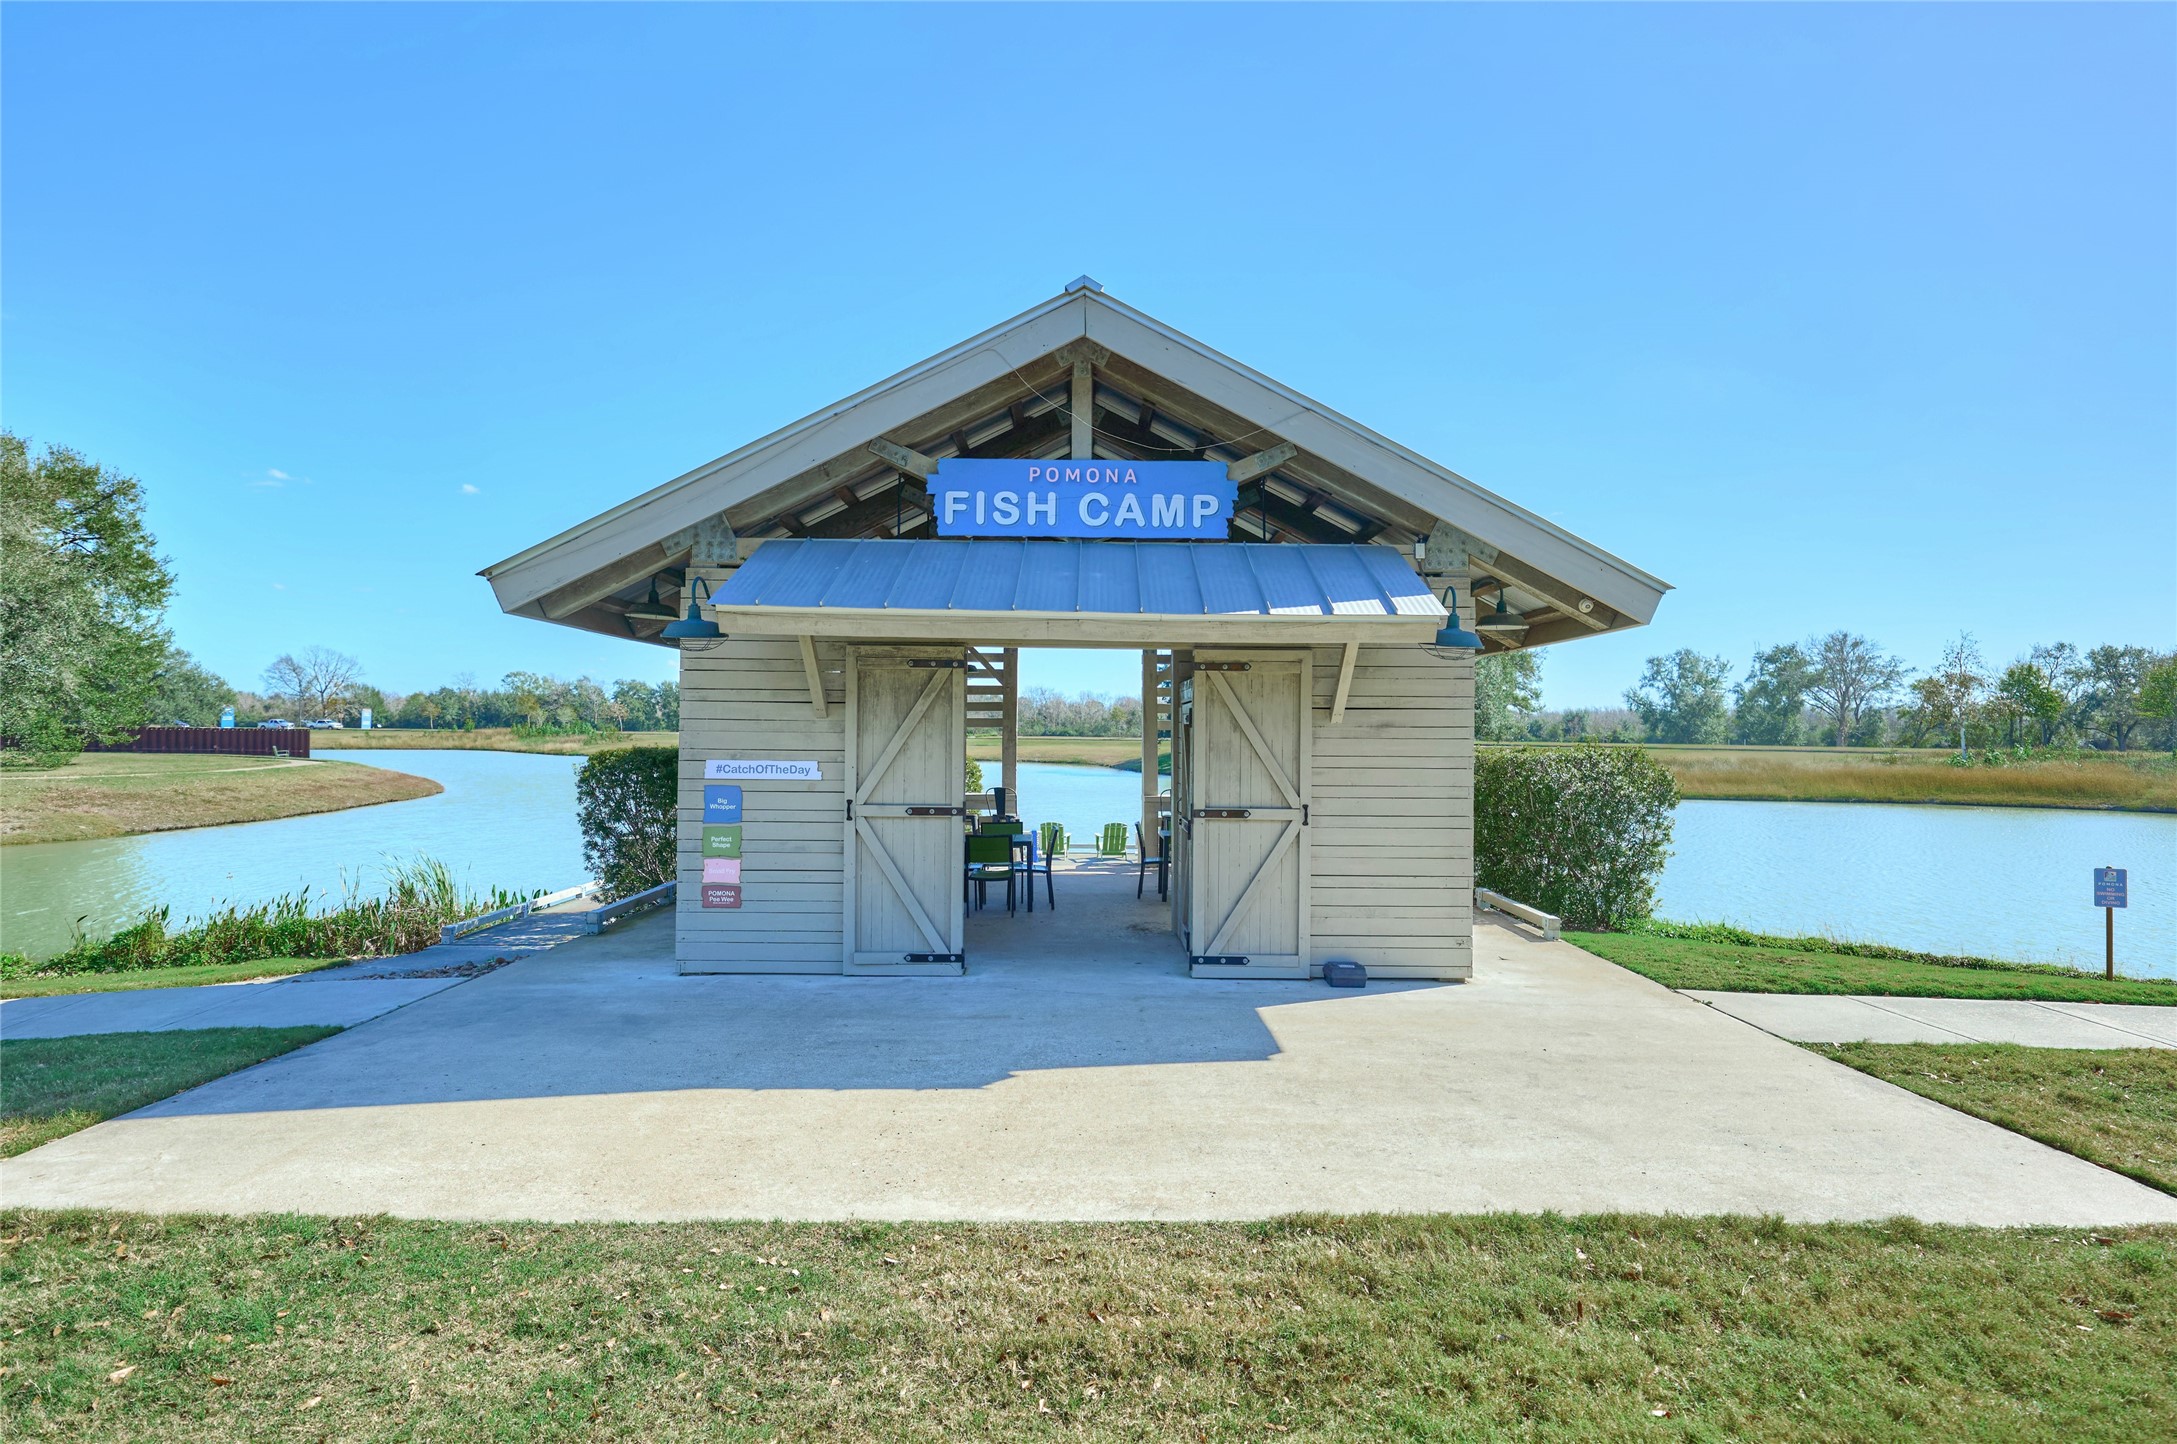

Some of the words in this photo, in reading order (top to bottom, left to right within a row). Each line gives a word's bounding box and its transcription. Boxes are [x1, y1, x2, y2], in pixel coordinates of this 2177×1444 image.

[1028, 467, 1137, 484] POMONA
[944, 491, 1057, 526] FISH
[1078, 492, 1220, 528] CAMP
[716, 764, 811, 776] #CatchOfTheDay
